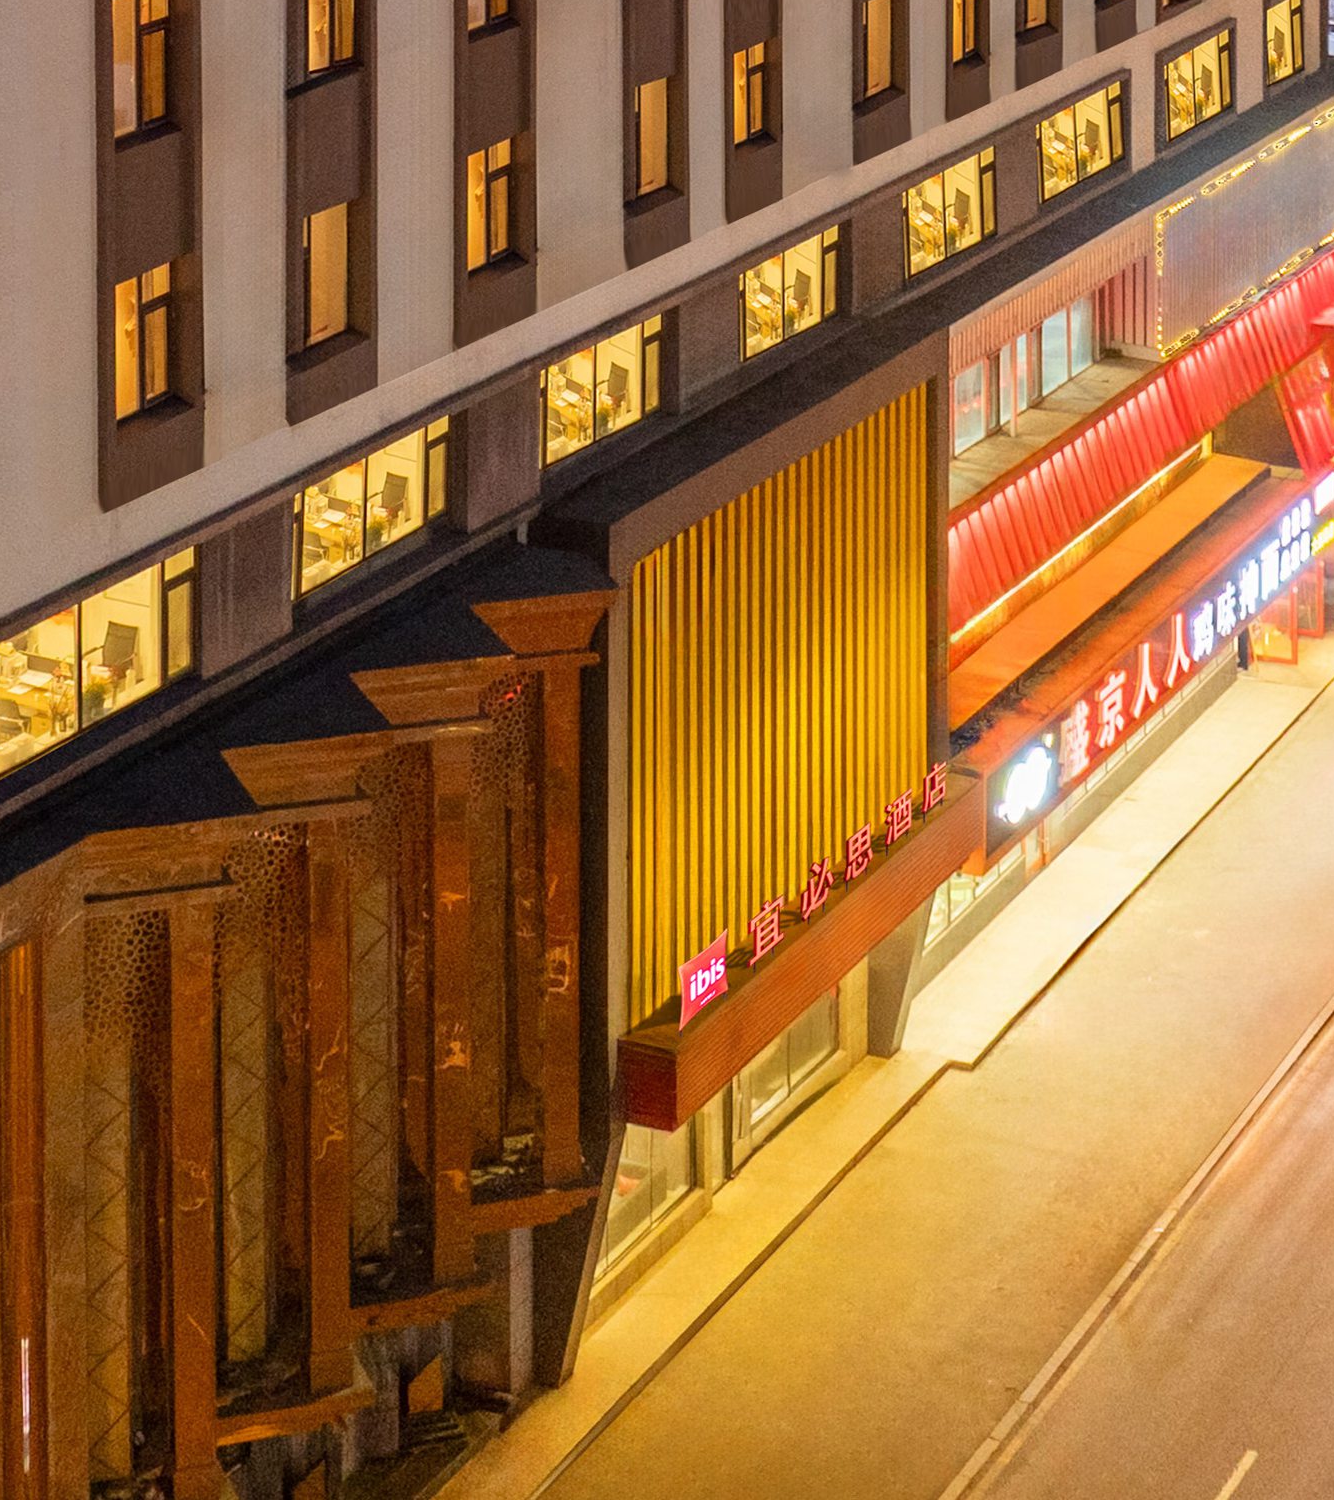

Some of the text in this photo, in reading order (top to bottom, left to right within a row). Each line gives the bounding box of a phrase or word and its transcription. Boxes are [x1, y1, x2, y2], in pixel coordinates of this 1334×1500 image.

[747, 761, 948, 968] 宜必思酒店
[690, 956, 726, 1002] ibis
